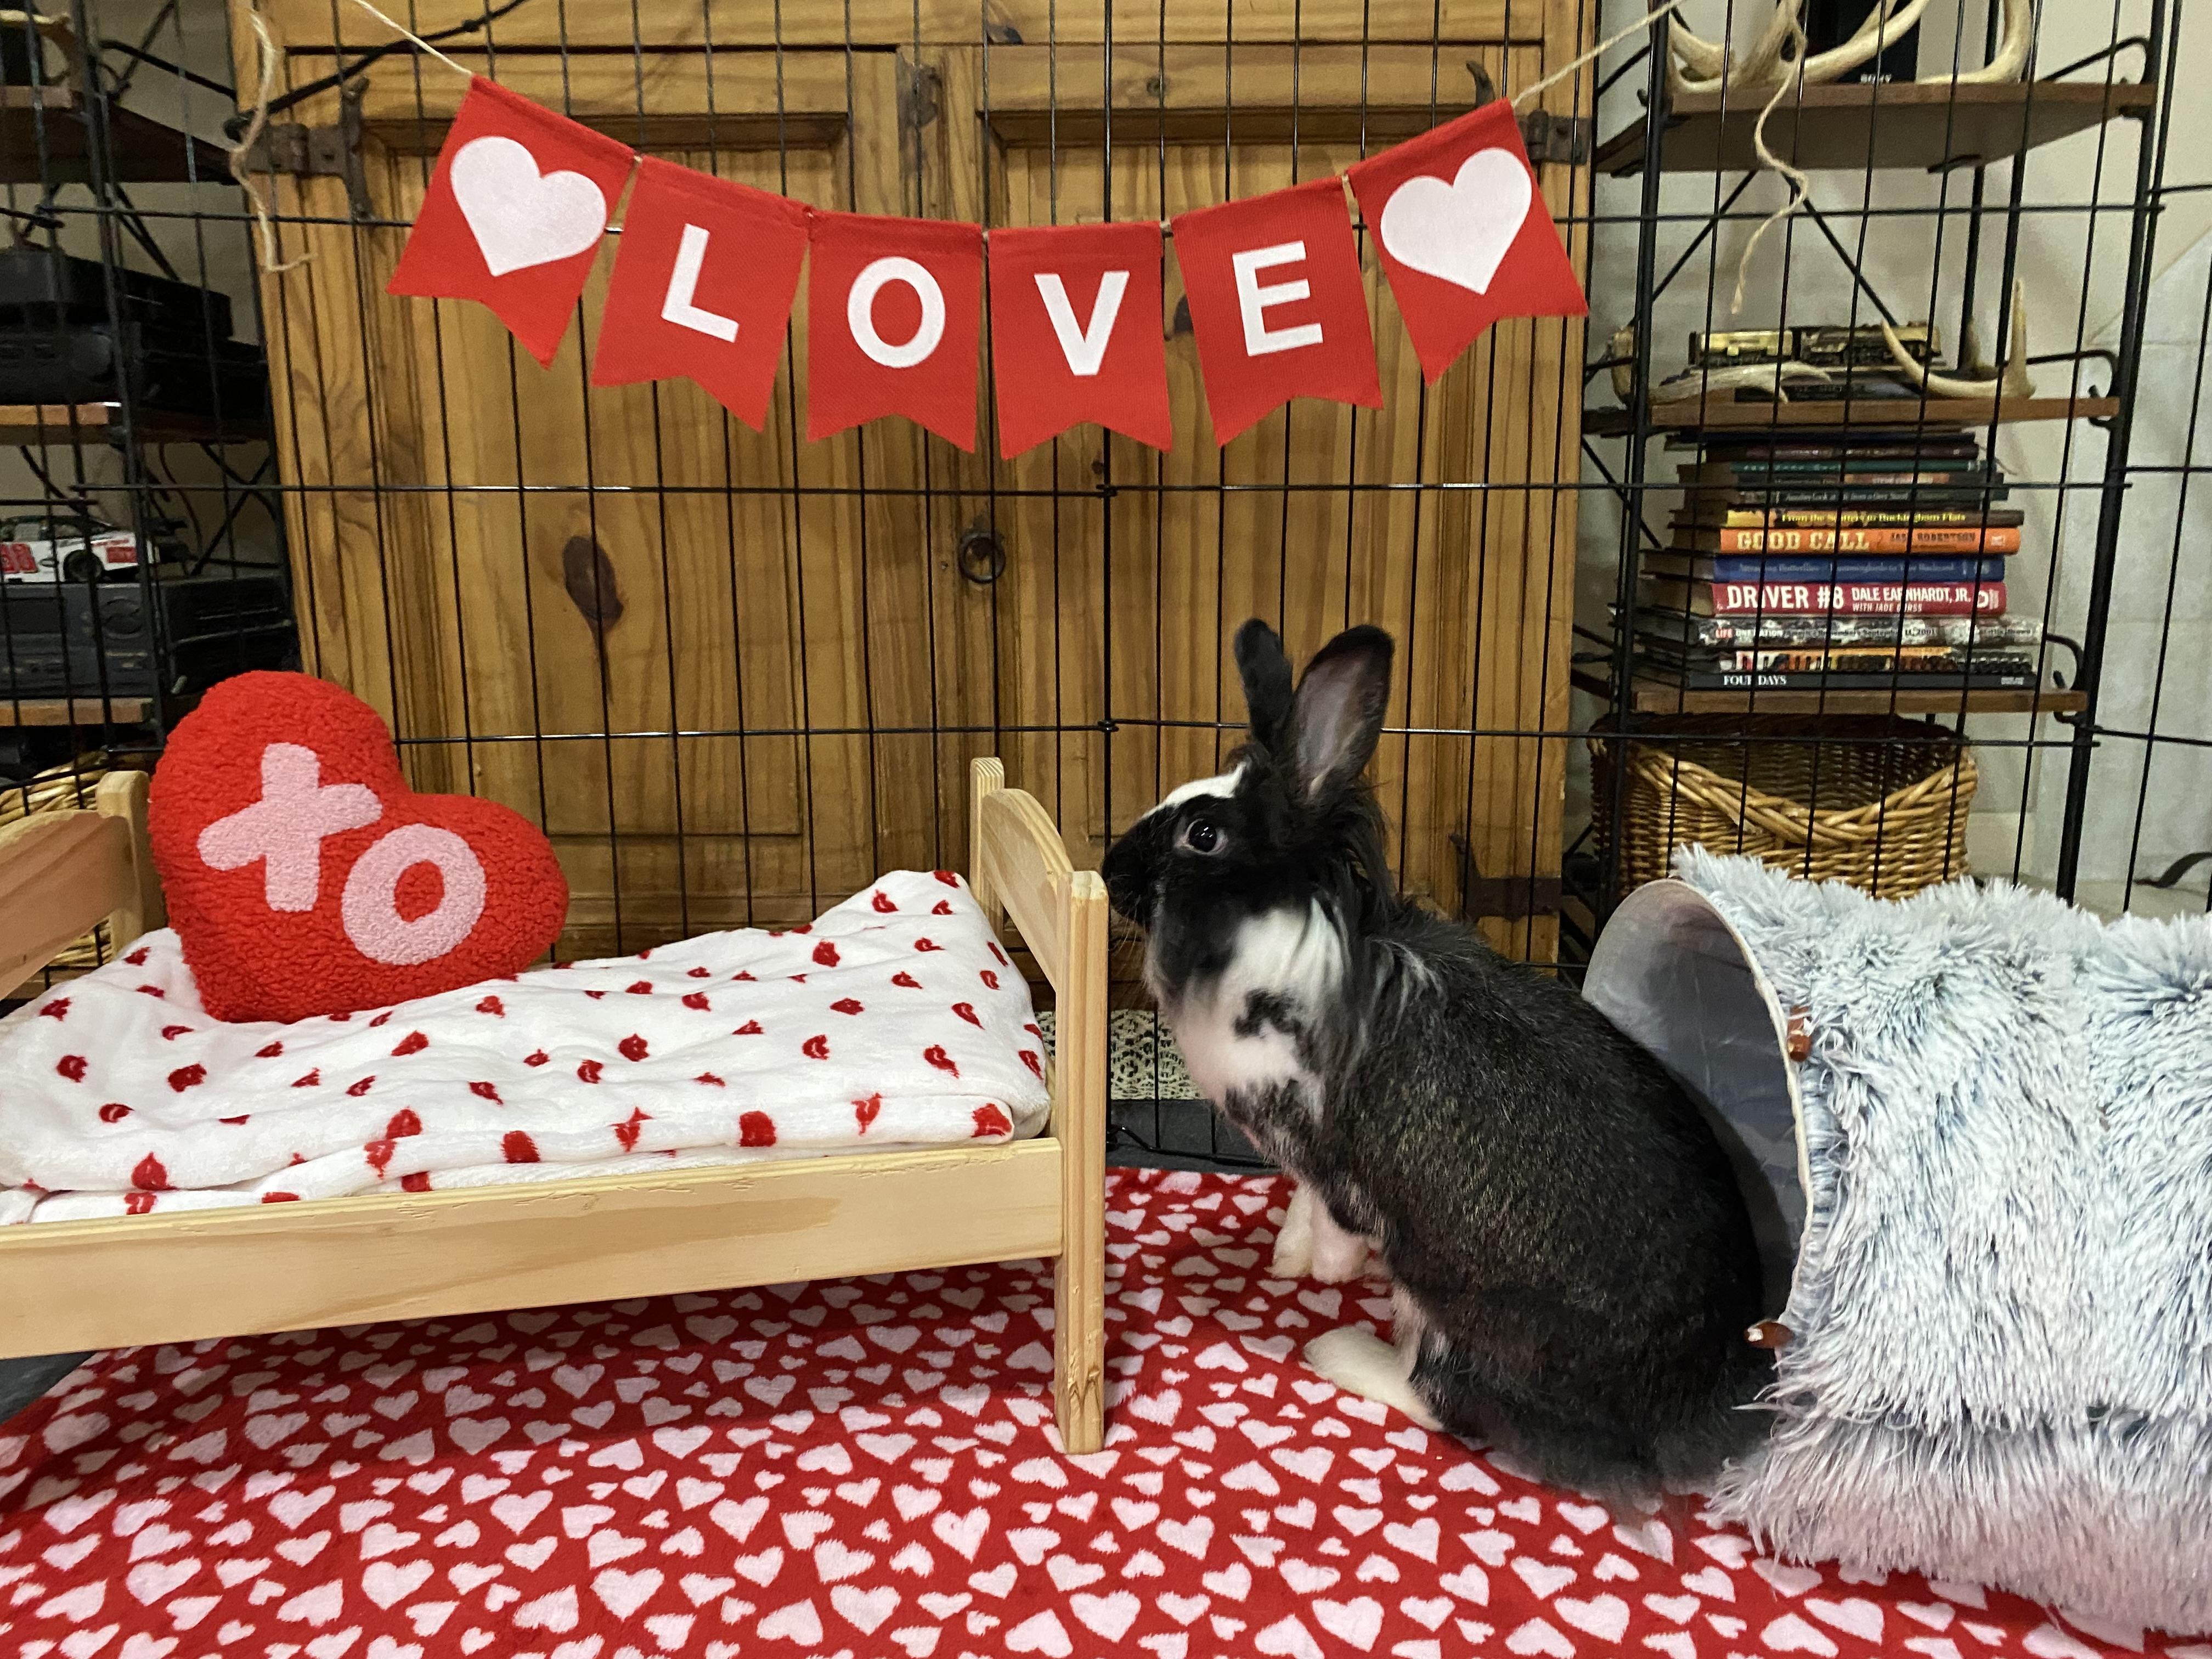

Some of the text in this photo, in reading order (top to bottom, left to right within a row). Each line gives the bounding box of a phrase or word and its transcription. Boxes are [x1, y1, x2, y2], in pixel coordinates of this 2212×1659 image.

[662, 224, 1323, 375] LOVE
[1737, 532, 1870, 550] GOOD CALL
[1727, 585, 1844, 609] DRIVER #8
[1852, 587, 1971, 603] DALE EARNHARDT, JR.
[1853, 603, 1872, 612] WITH
[1754, 629, 1783, 638] ATION
[1758, 674, 1787, 686] DAYS
